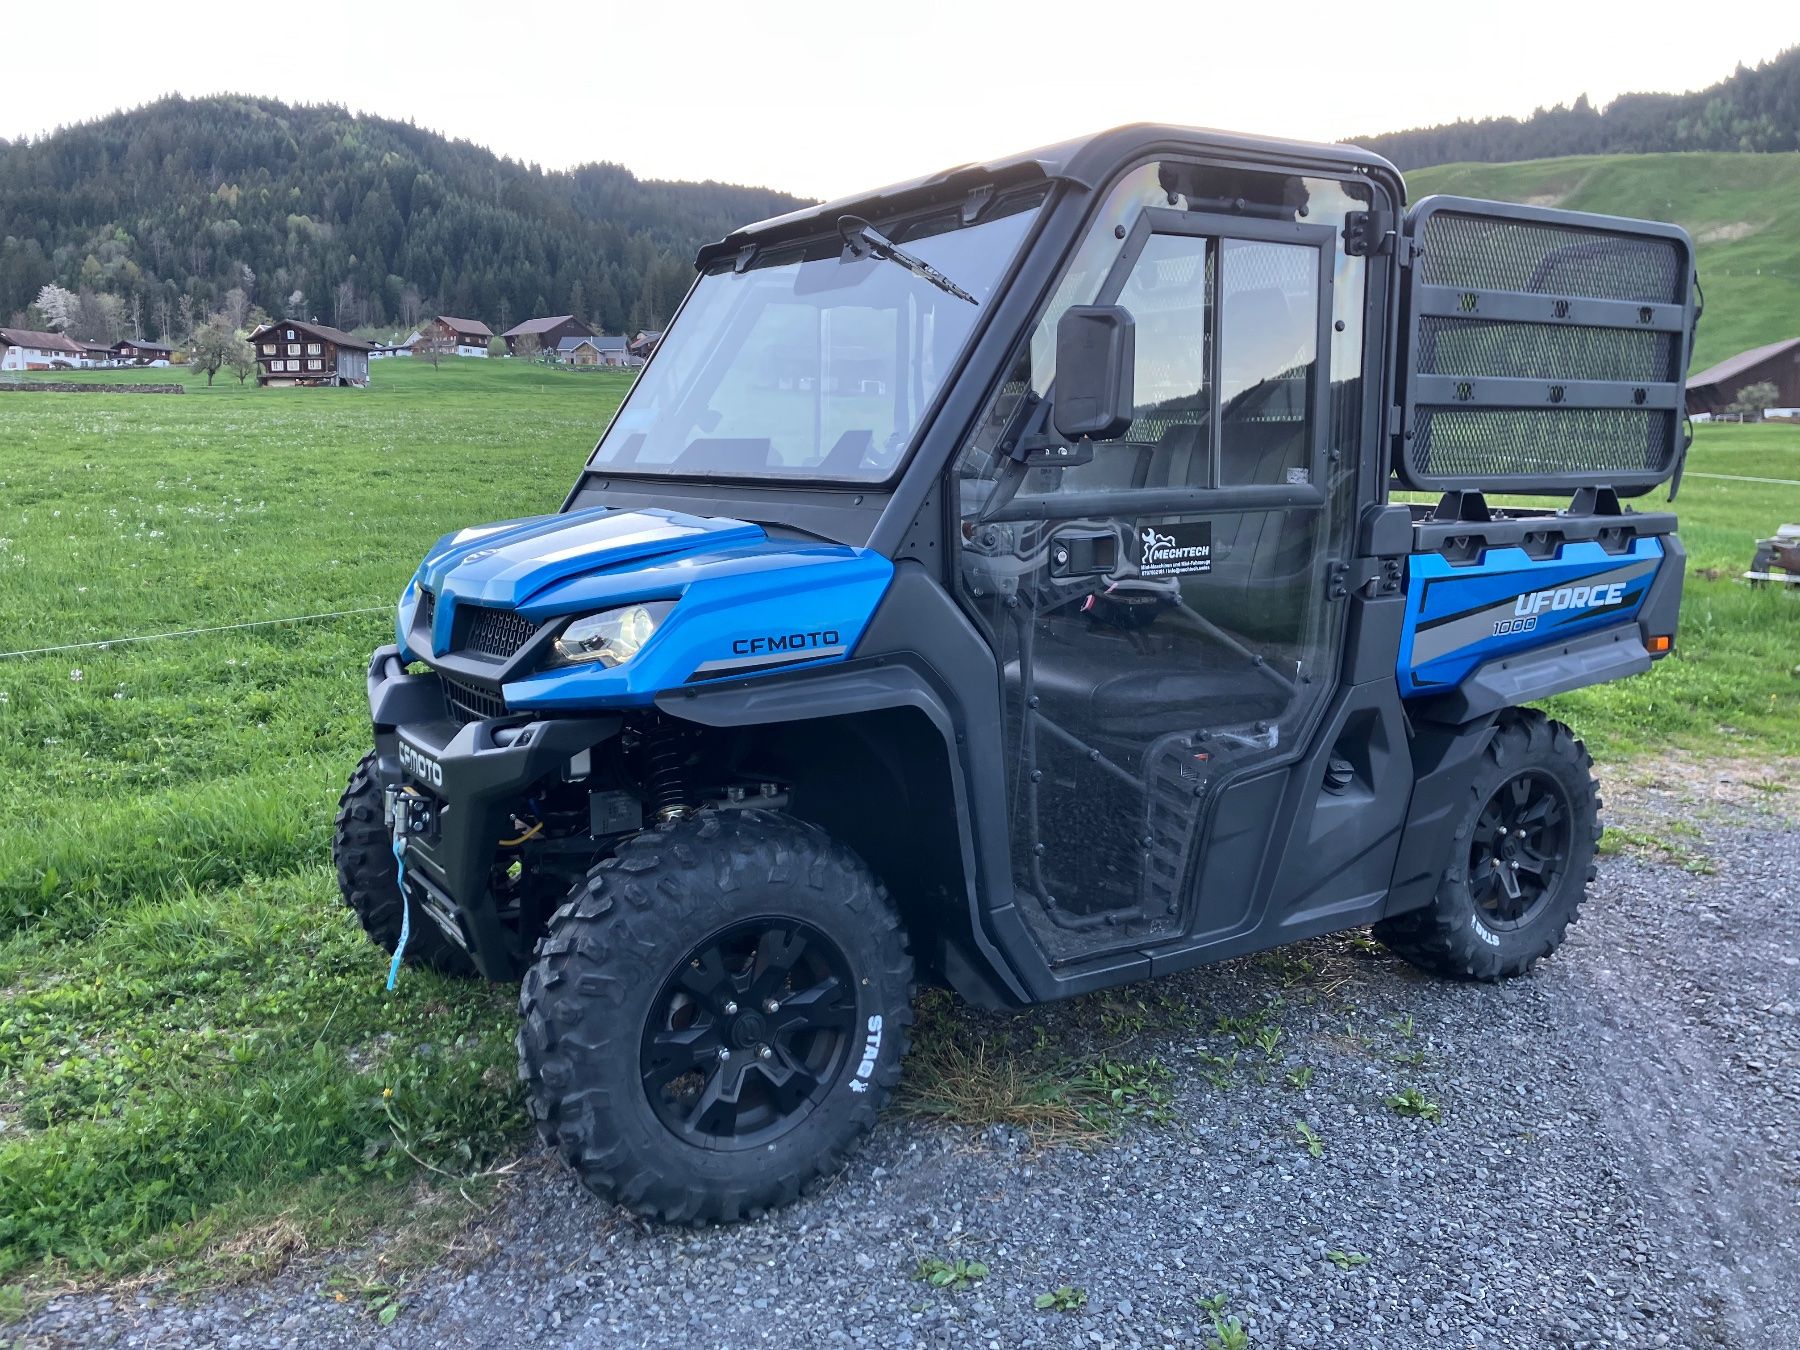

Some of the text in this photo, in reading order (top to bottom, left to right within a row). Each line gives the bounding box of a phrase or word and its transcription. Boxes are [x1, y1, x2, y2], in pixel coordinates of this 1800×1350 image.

[1154, 546, 1210, 560] MECHTECH
[1514, 582, 1627, 617] UFORCE
[1493, 616, 1538, 636] 1000
[732, 630, 839, 654] CFMOTO
[398, 740, 443, 787] CFMOTO
[1475, 921, 1500, 947] STAG
[855, 1014, 883, 1079] STAG
